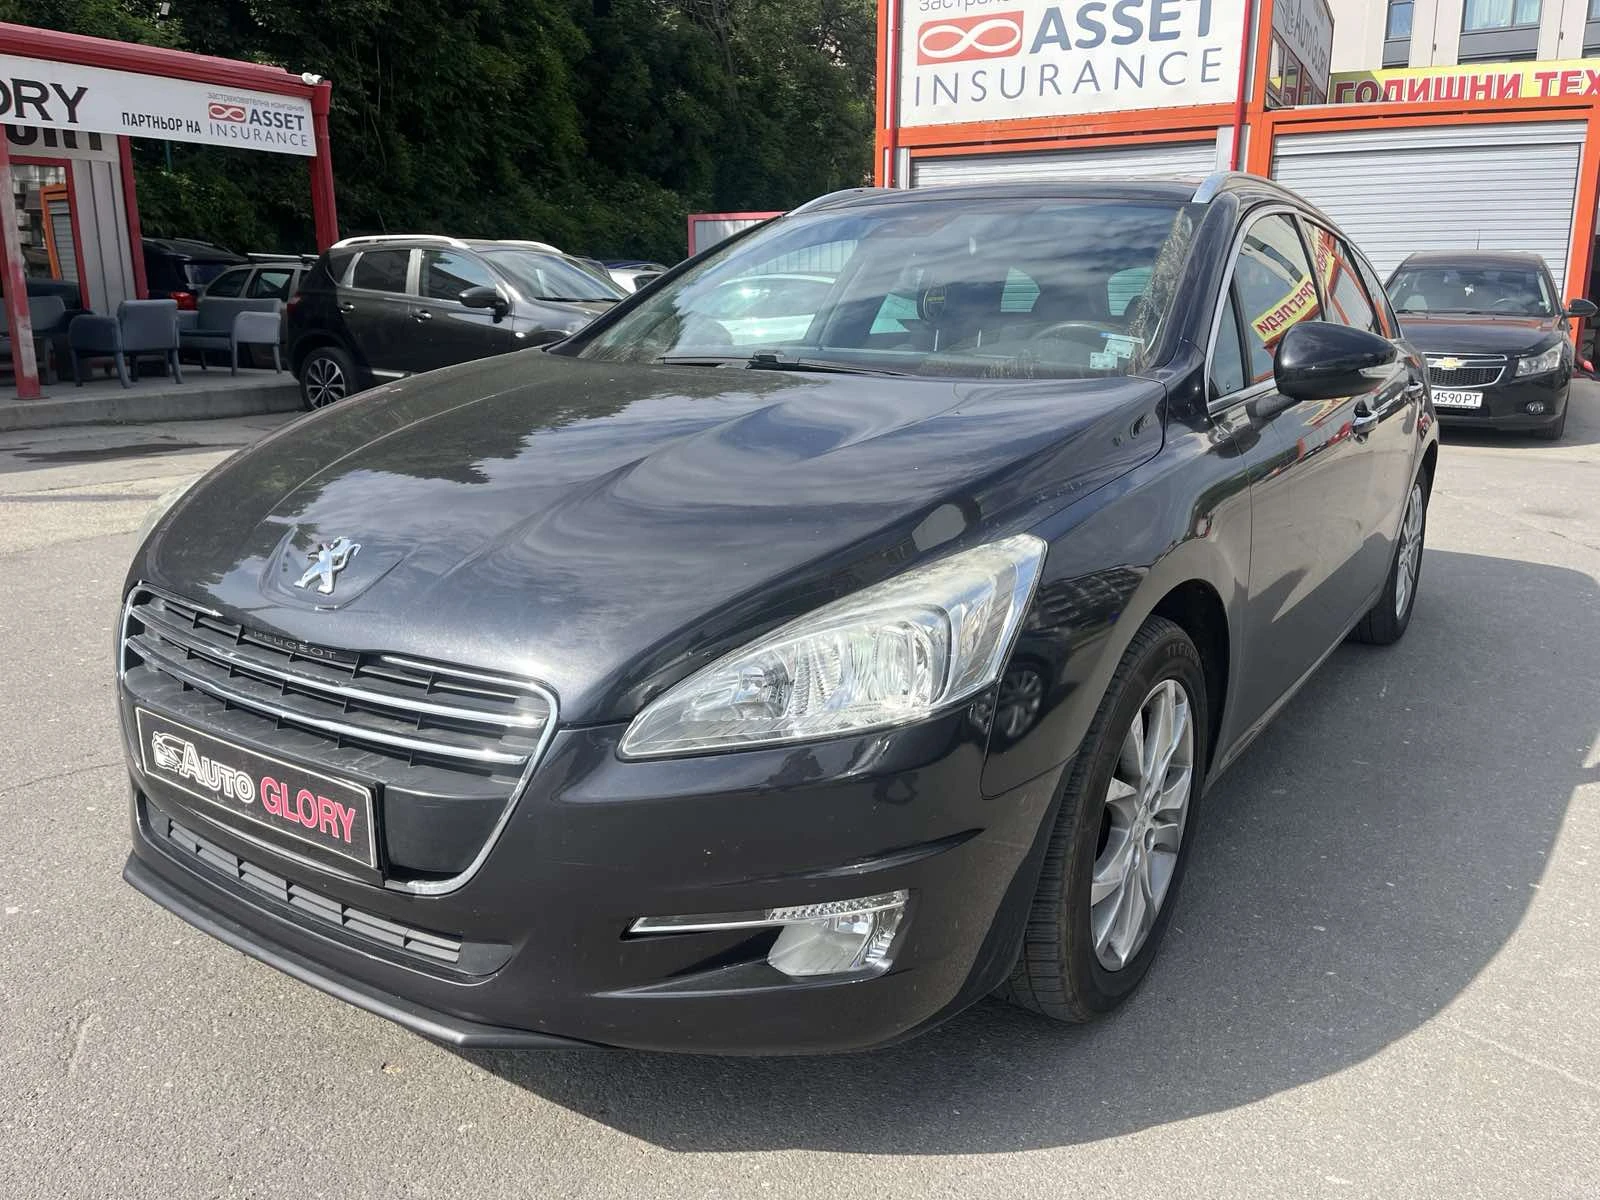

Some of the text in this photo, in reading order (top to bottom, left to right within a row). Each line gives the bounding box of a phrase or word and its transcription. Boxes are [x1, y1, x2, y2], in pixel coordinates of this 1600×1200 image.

[1029, 0, 1213, 54] ASSET
[915, 48, 1222, 107] INSURANCE
[1334, 72, 1522, 103] ГОДИШНИ
[0, 78, 88, 123] RY
[122, 112, 201, 134] ПАРТНЬОР НА
[209, 123, 309, 147] INSURANCE
[249, 109, 305, 131] ASSET
[254, 631, 336, 659] PEUGEOT
[179, 741, 355, 843] AUTO GLORY
